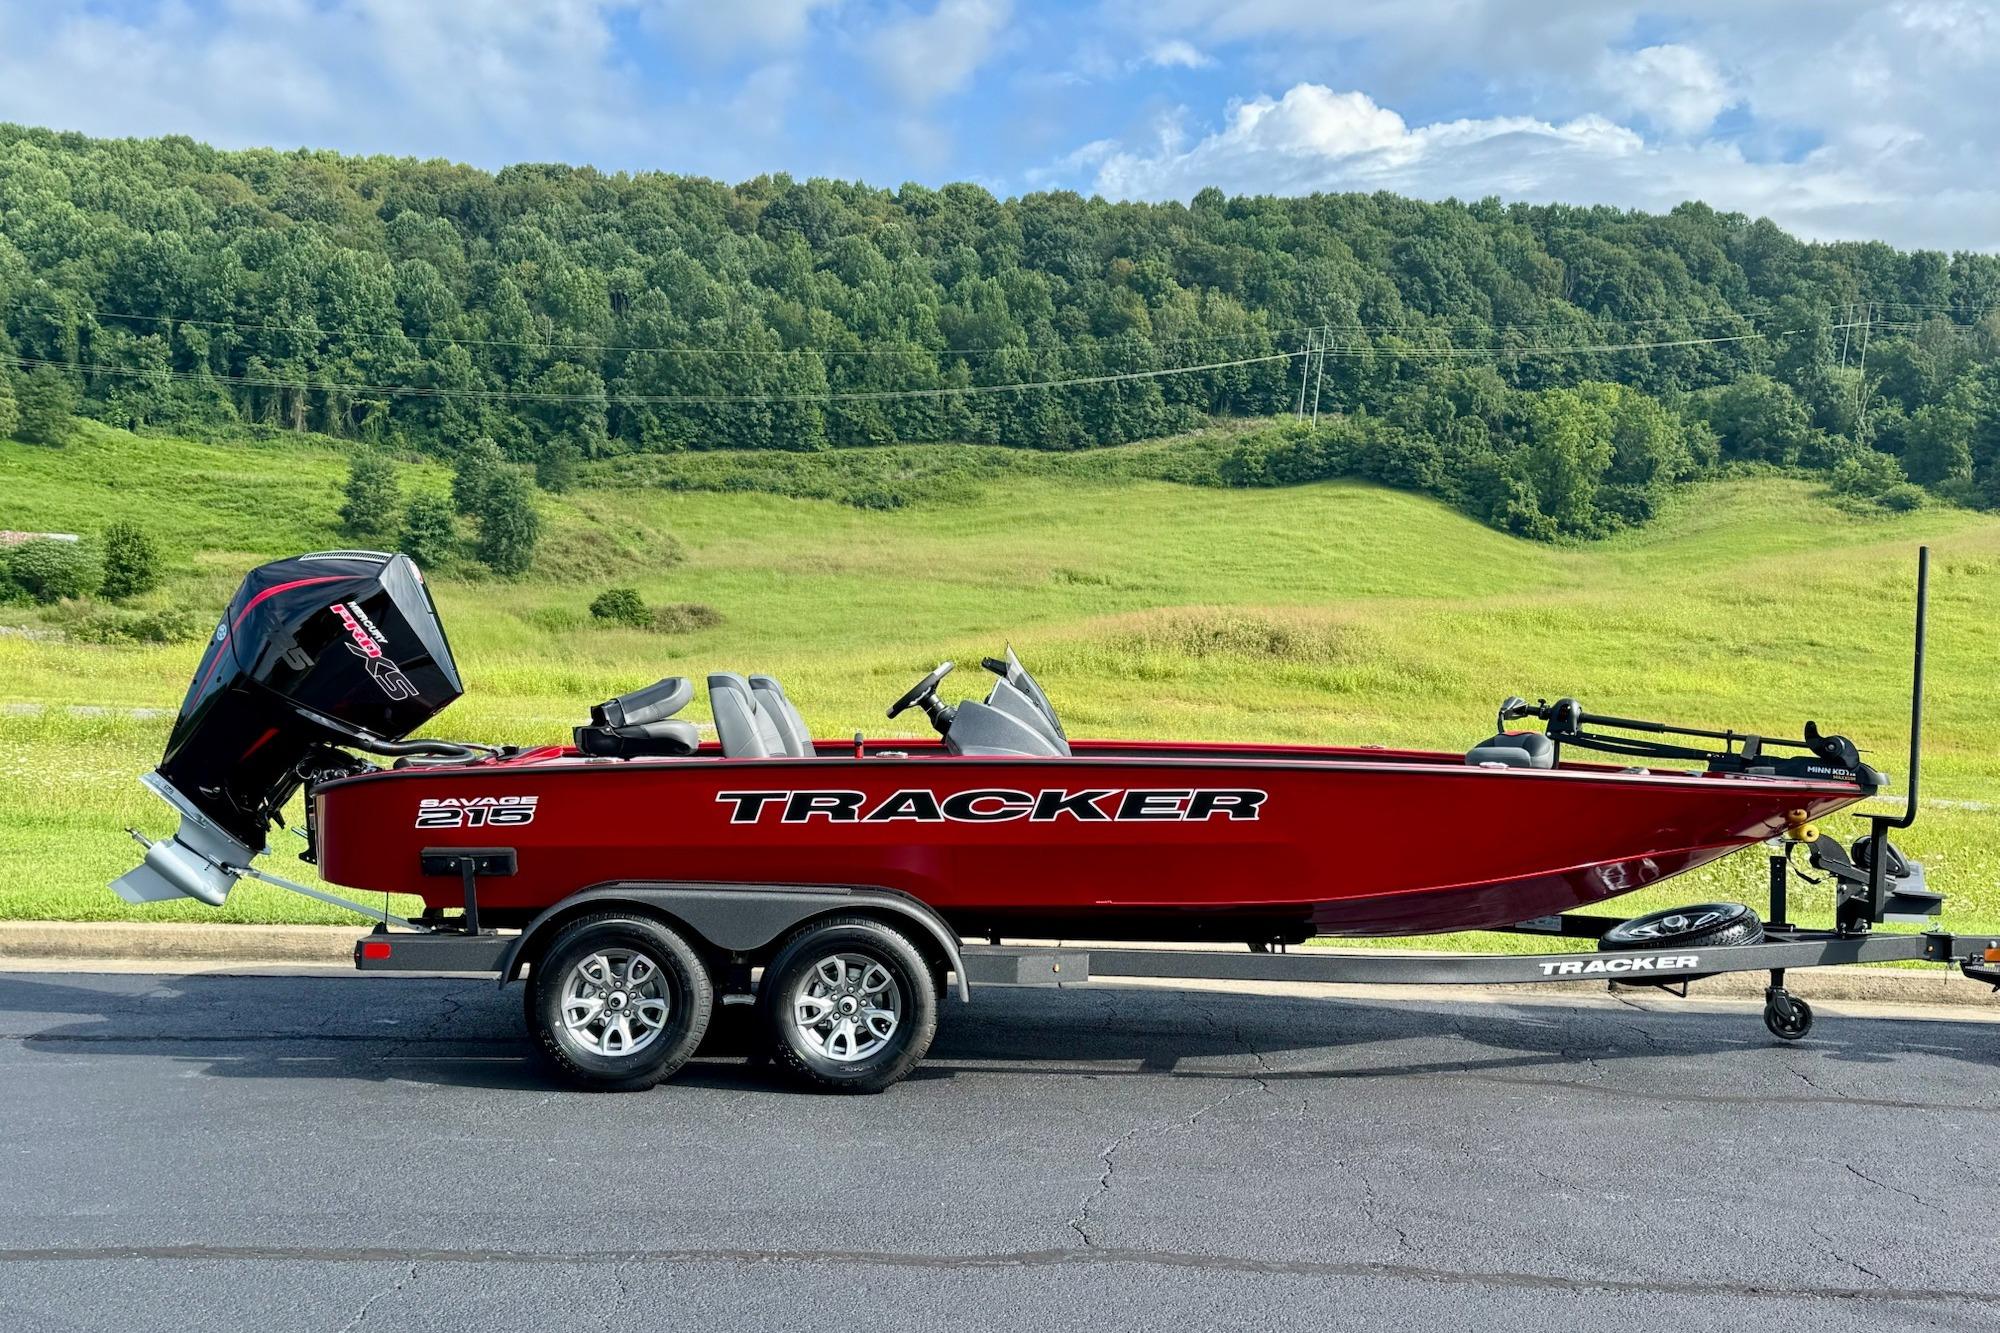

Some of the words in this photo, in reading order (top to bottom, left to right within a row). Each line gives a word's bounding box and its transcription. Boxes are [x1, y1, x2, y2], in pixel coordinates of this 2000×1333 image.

[330, 604, 382, 658] PRO
[347, 601, 388, 643] MERCURY
[344, 642, 420, 700] XS
[1807, 766, 1831, 774] MINN
[419, 796, 539, 807] SAVAGE
[715, 788, 1268, 823] TRACKER
[415, 805, 536, 828] 215
[1539, 956, 1699, 976] TRACKER
